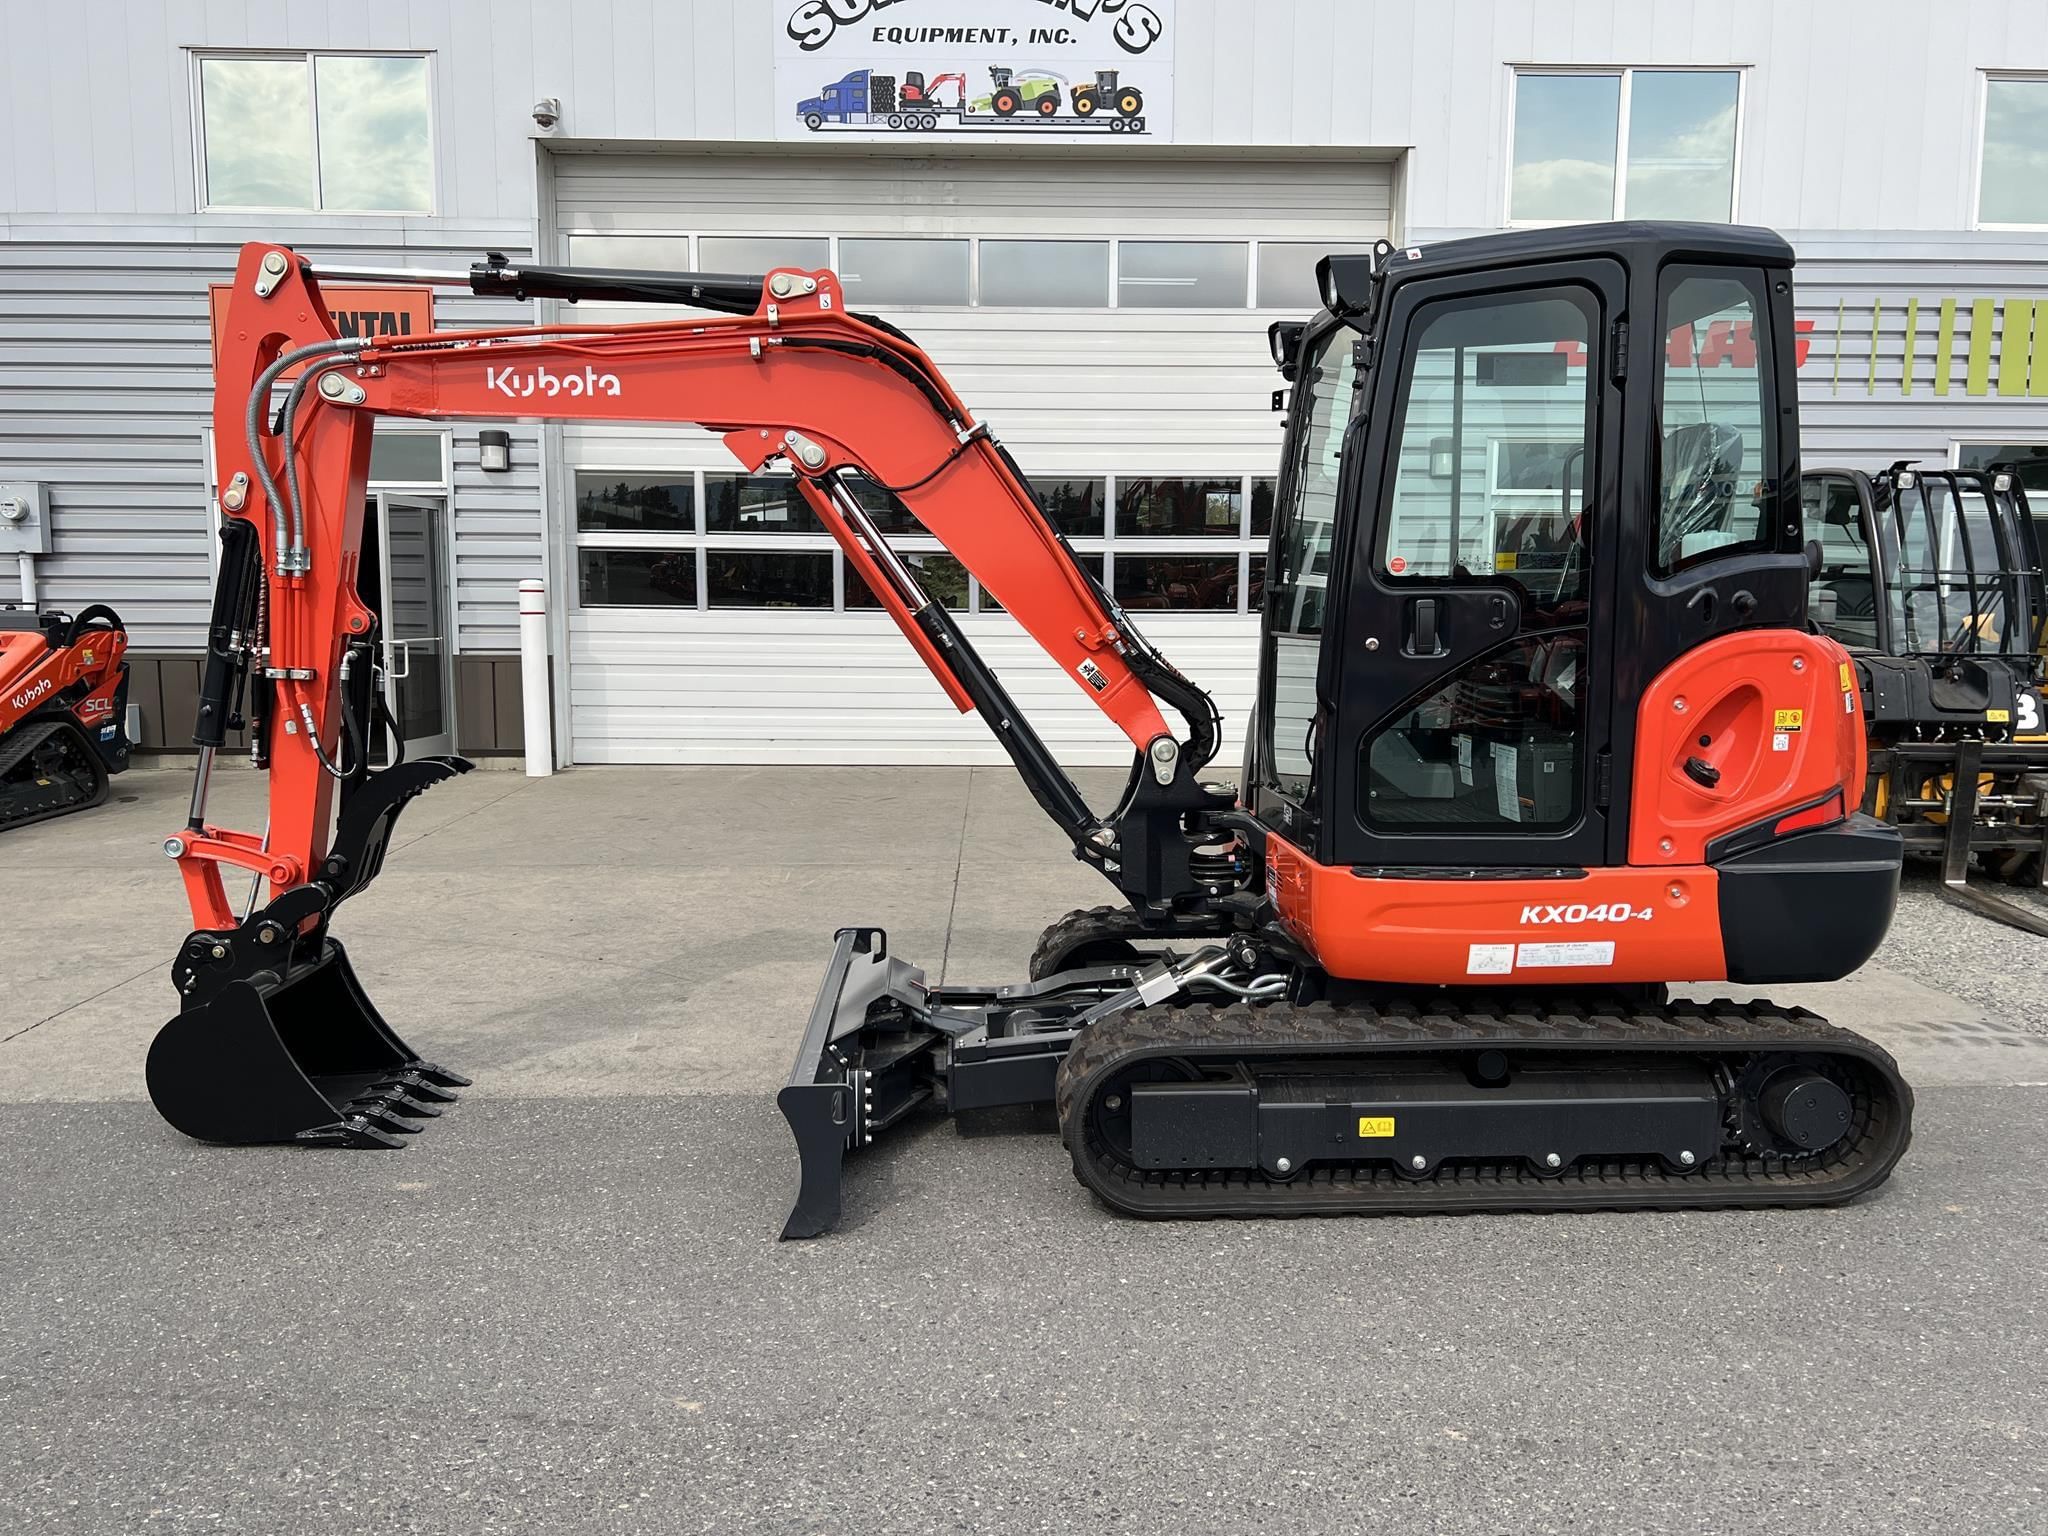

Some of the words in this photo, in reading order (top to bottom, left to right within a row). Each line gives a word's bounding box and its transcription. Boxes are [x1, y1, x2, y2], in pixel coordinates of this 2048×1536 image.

[872, 27, 1018, 46] EQUIPMENT,
[1029, 28, 1077, 44] INC.
[487, 366, 621, 397] Kubota
[12, 678, 52, 710] Kubota
[1519, 903, 1653, 924] KX040-4
